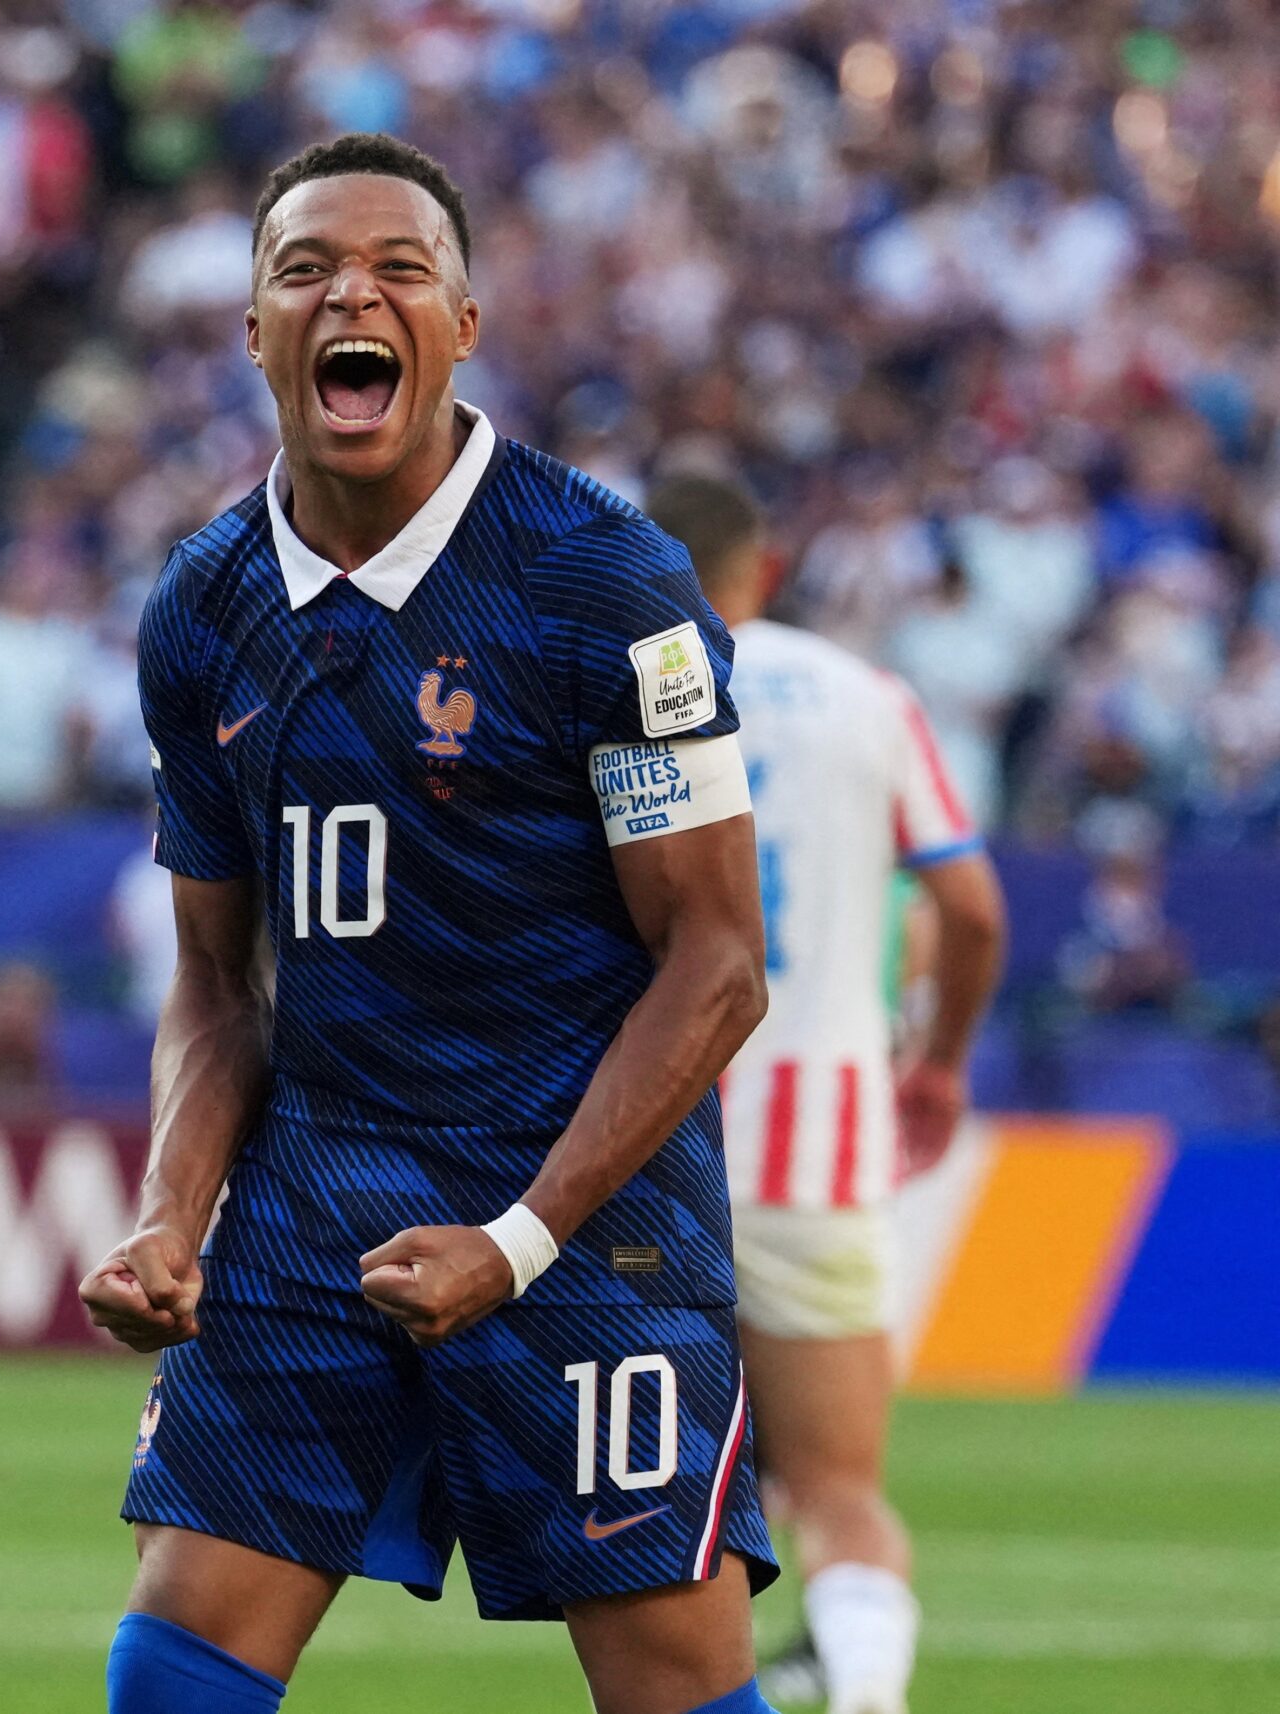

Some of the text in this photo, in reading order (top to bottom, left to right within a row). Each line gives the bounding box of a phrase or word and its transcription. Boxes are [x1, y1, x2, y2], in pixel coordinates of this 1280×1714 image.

[655, 685, 704, 714] EDUCATION
[660, 678, 684, 696] Unite
[675, 709, 694, 720] FIFA
[593, 741, 674, 772] FOOTBALL
[595, 757, 680, 797] UNITES
[601, 780, 691, 821] the World
[628, 816, 668, 833] FIFA
[283, 804, 387, 938] 10
[565, 1354, 678, 1494] 10
